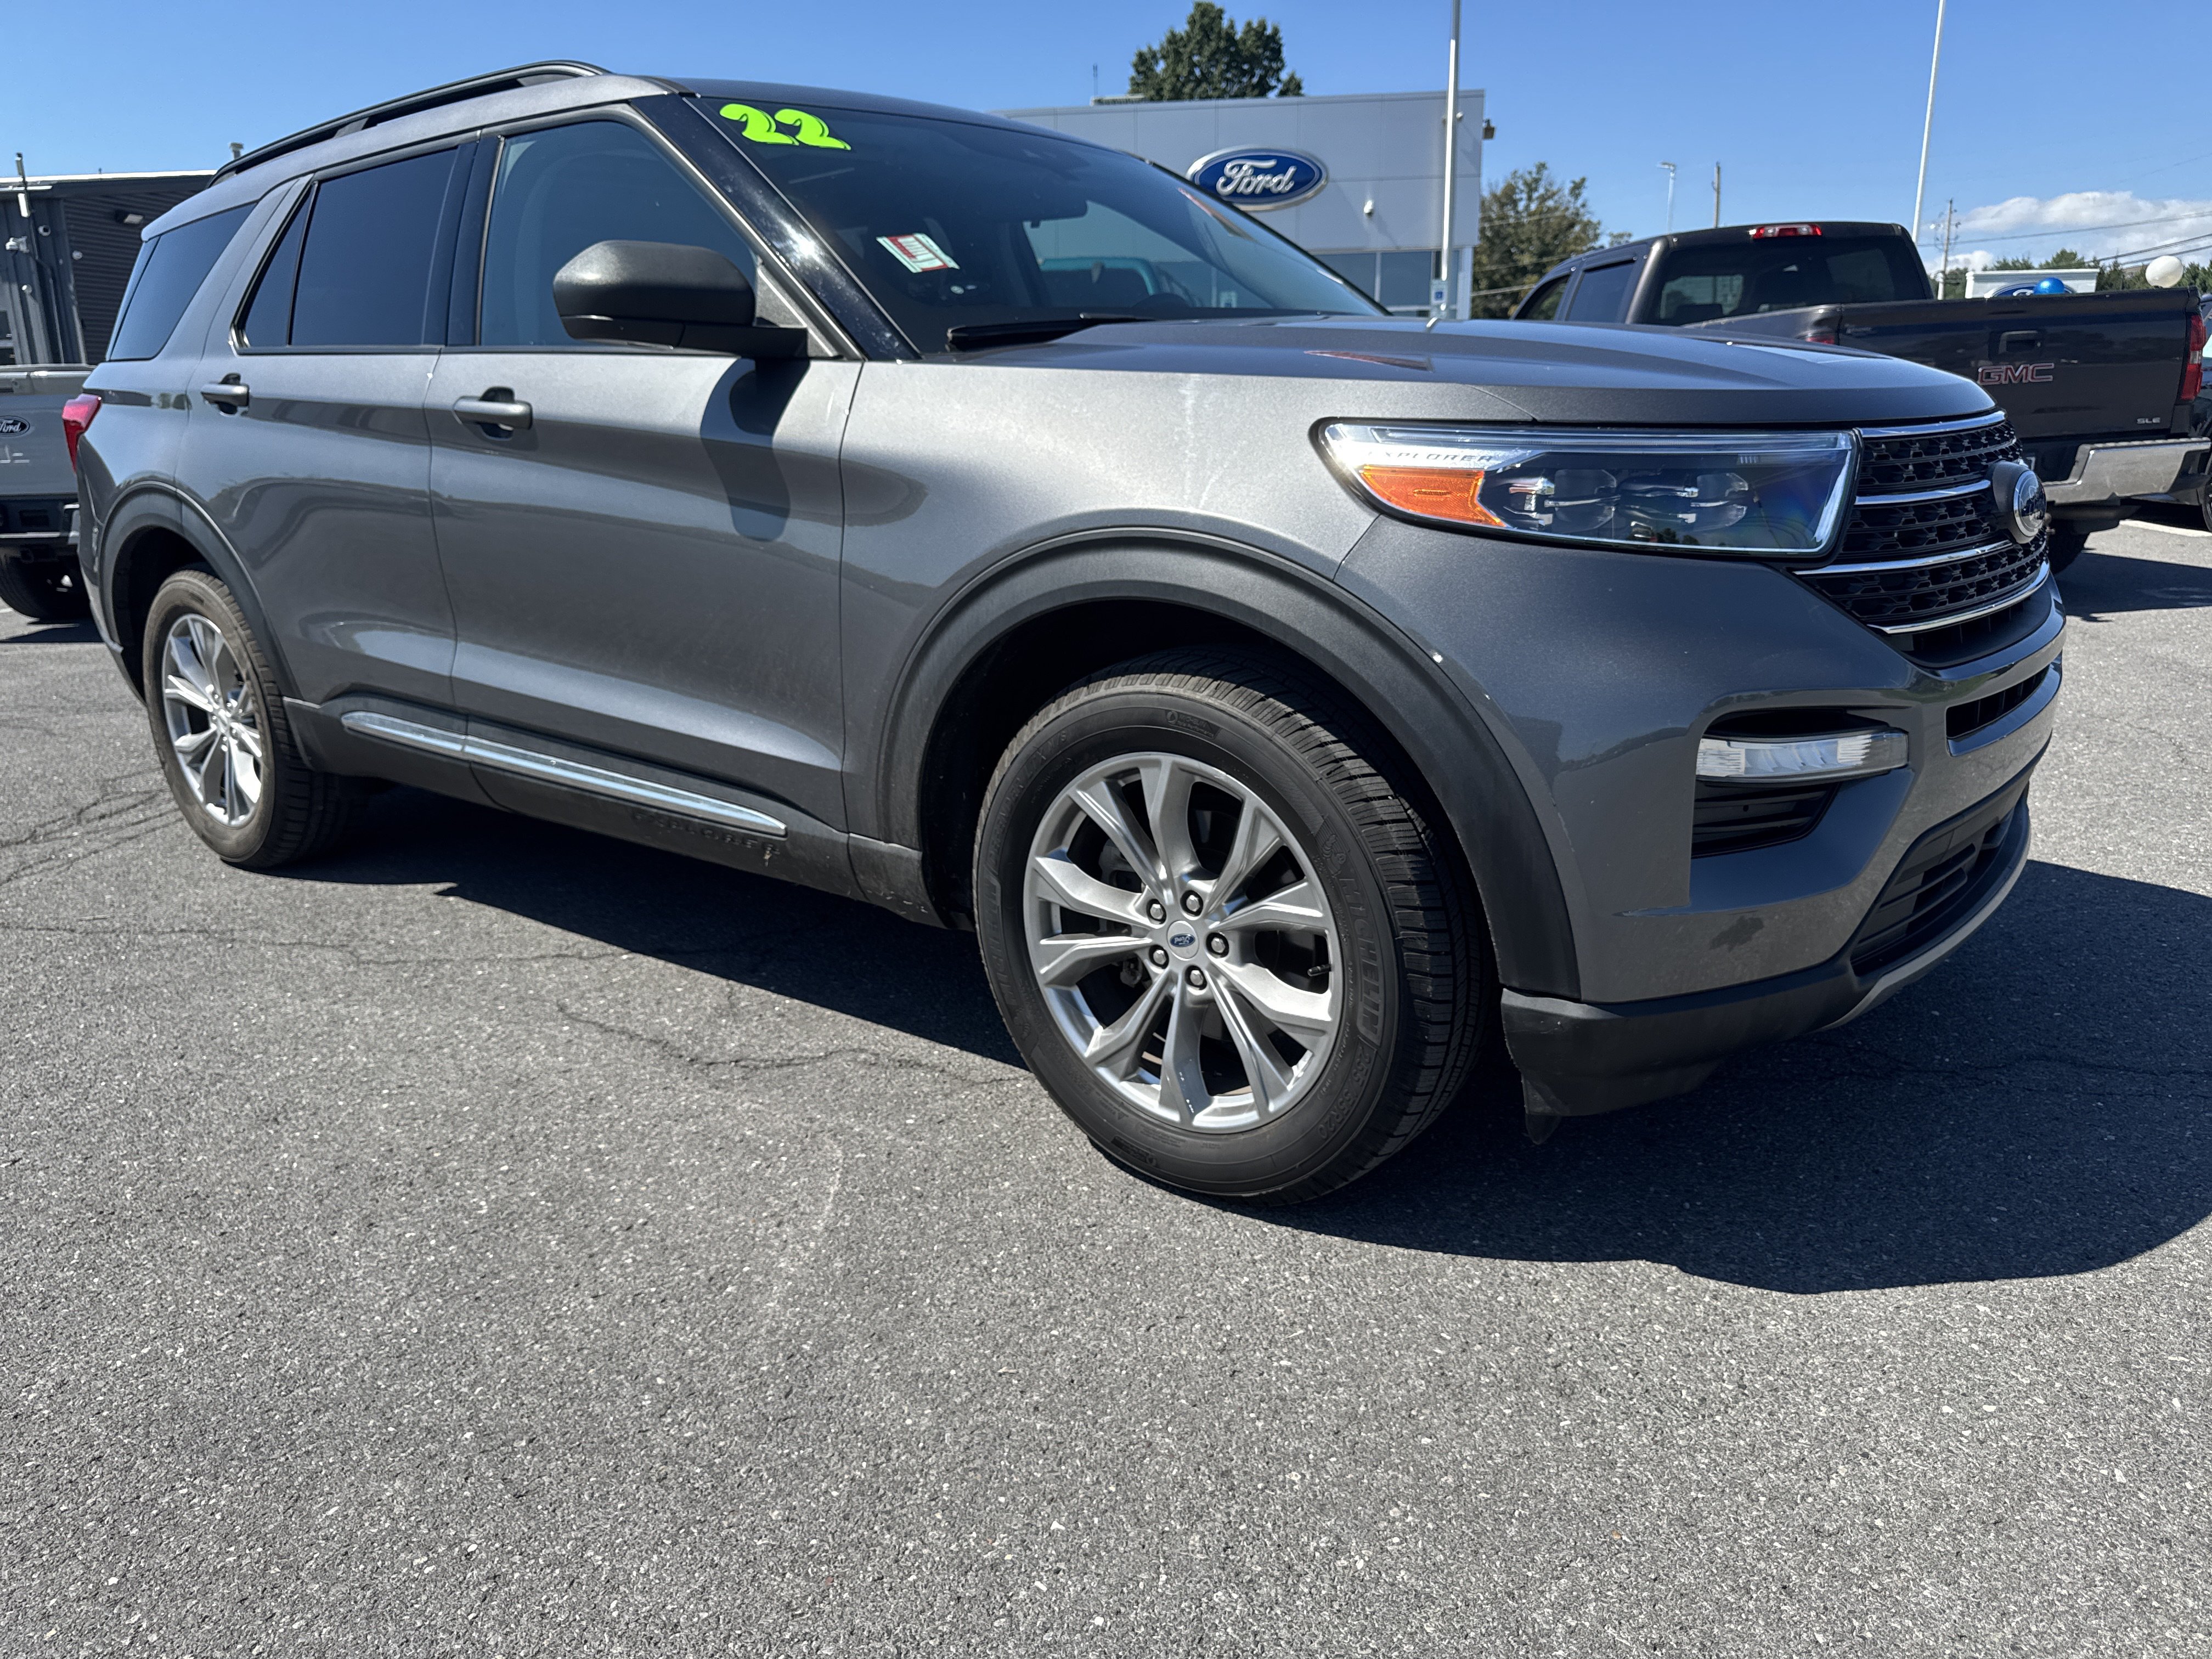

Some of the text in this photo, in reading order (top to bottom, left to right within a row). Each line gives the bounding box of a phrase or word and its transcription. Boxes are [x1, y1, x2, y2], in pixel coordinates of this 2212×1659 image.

[719, 103, 851, 150] 22
[1216, 159, 1297, 196] Ford
[1978, 362, 2055, 385] GMC
[1173, 936, 1190, 945] Ford
[1338, 877, 1382, 1047] MICHELIN
[1318, 1046, 1371, 1139] 255/55R20
